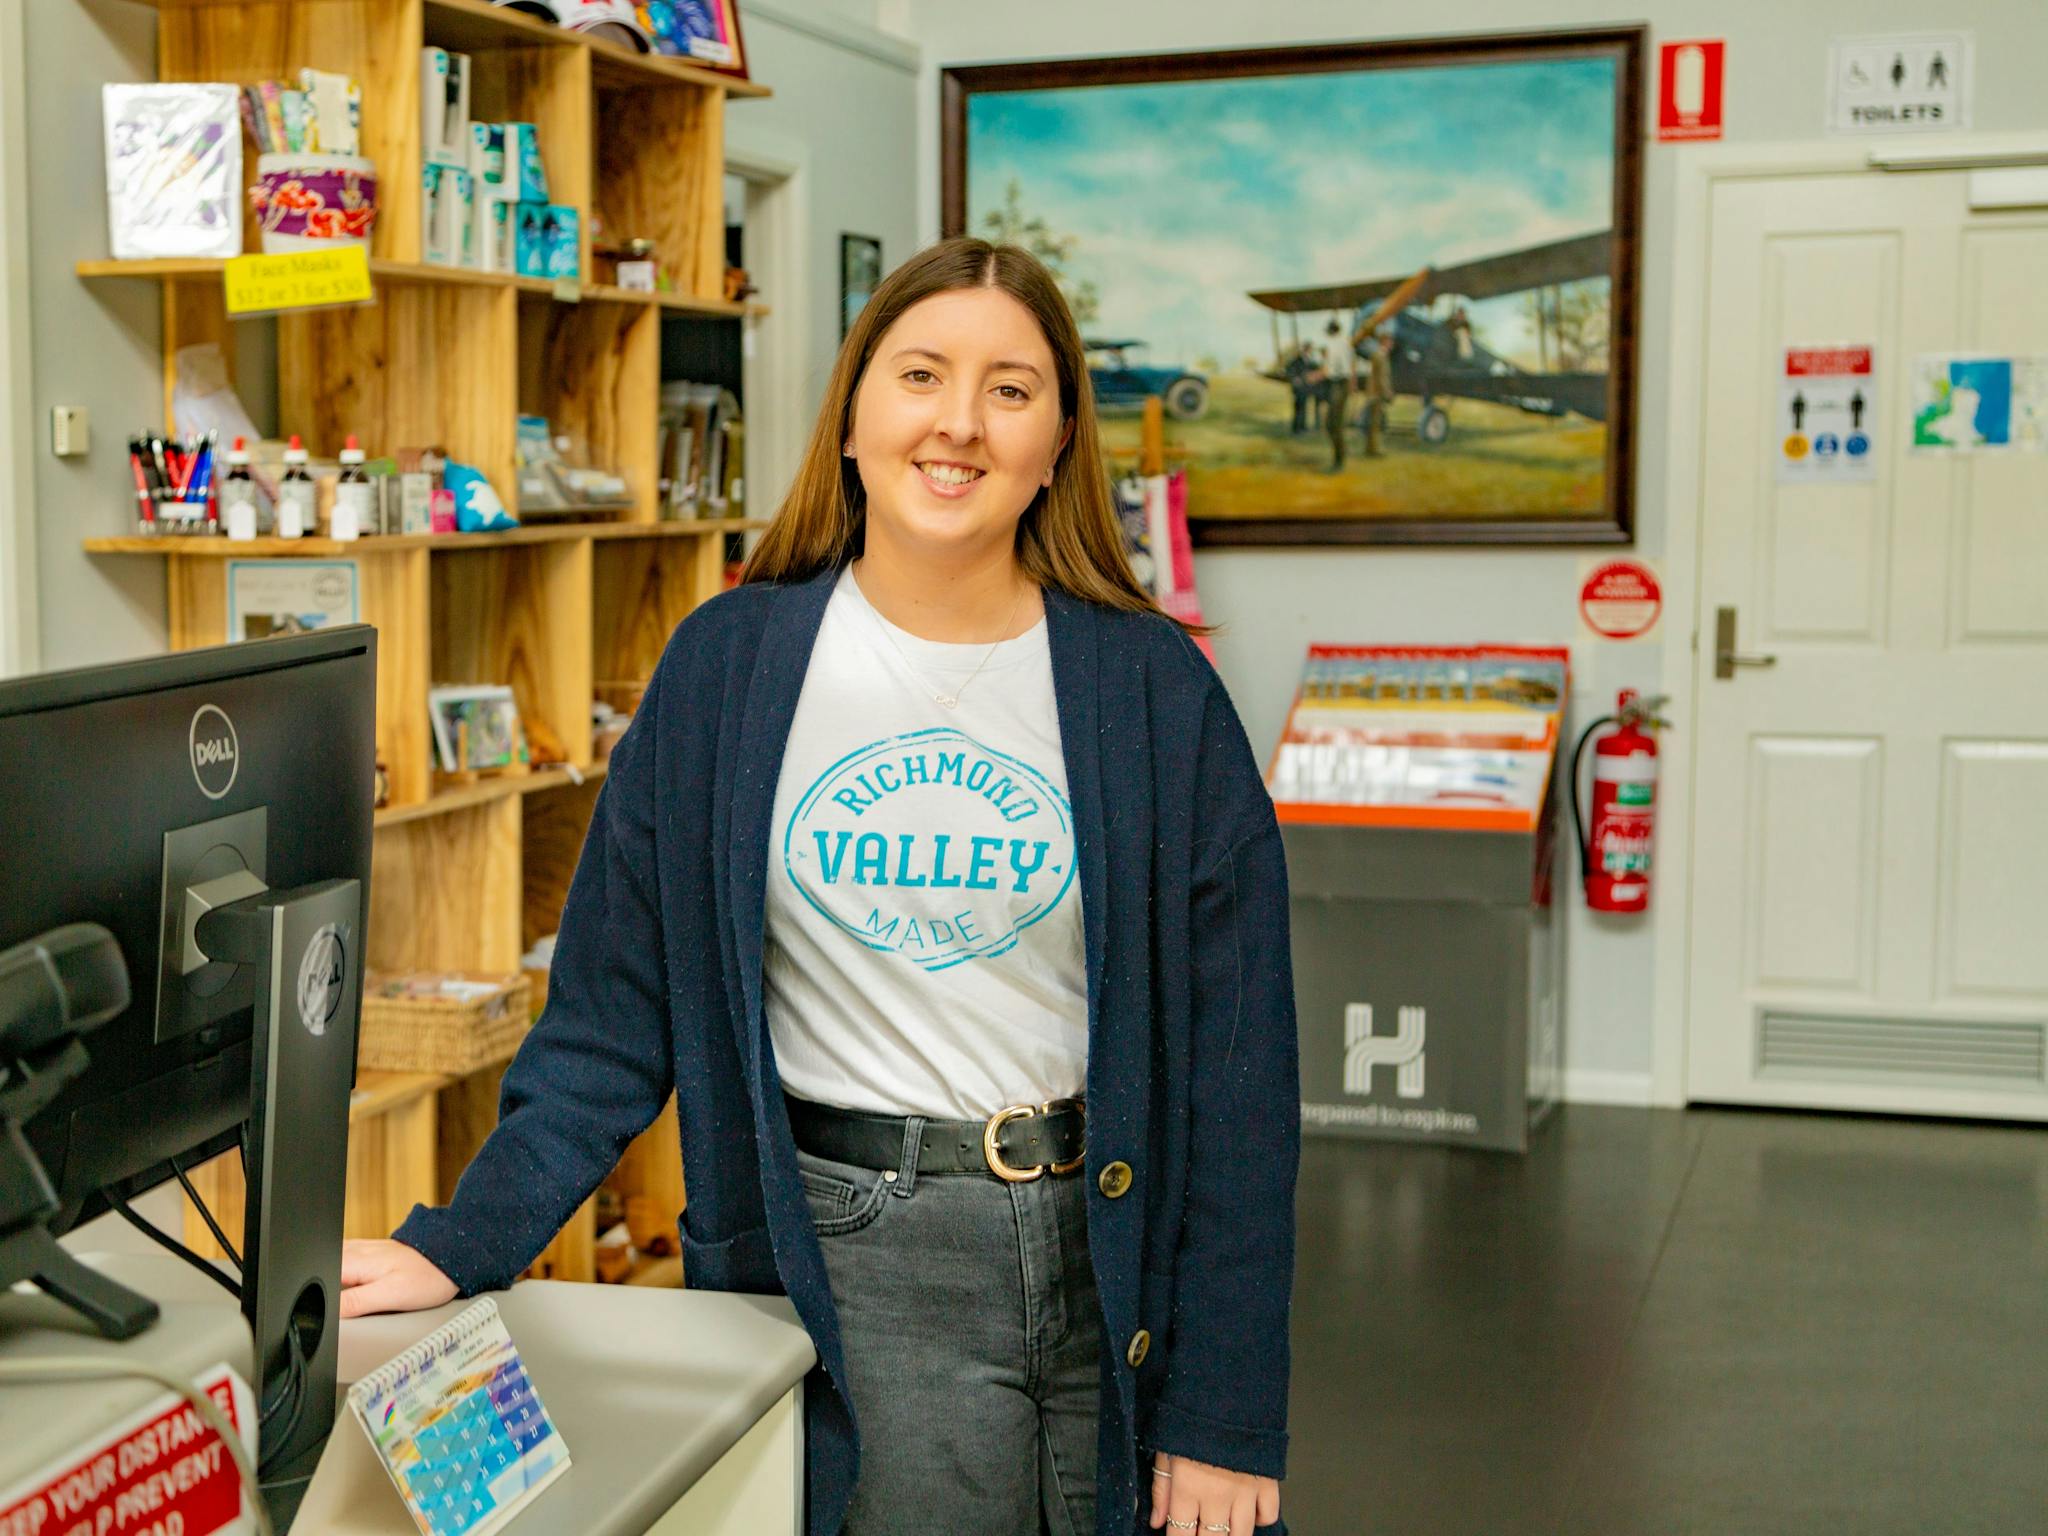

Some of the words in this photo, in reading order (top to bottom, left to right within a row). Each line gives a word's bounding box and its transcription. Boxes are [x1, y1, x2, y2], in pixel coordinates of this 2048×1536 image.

[1850, 104, 1943, 123] TOILETS
[195, 737, 234, 766] DELL
[831, 751, 1040, 823] RICHMOND
[812, 830, 1050, 893] VALLEY
[865, 907, 984, 949] MADE
[1301, 1103, 1378, 1127] repared
[48, 1453, 117, 1521] YOUR
[118, 1387, 233, 1479] DISTANE
[115, 1439, 223, 1530] PREVENT
